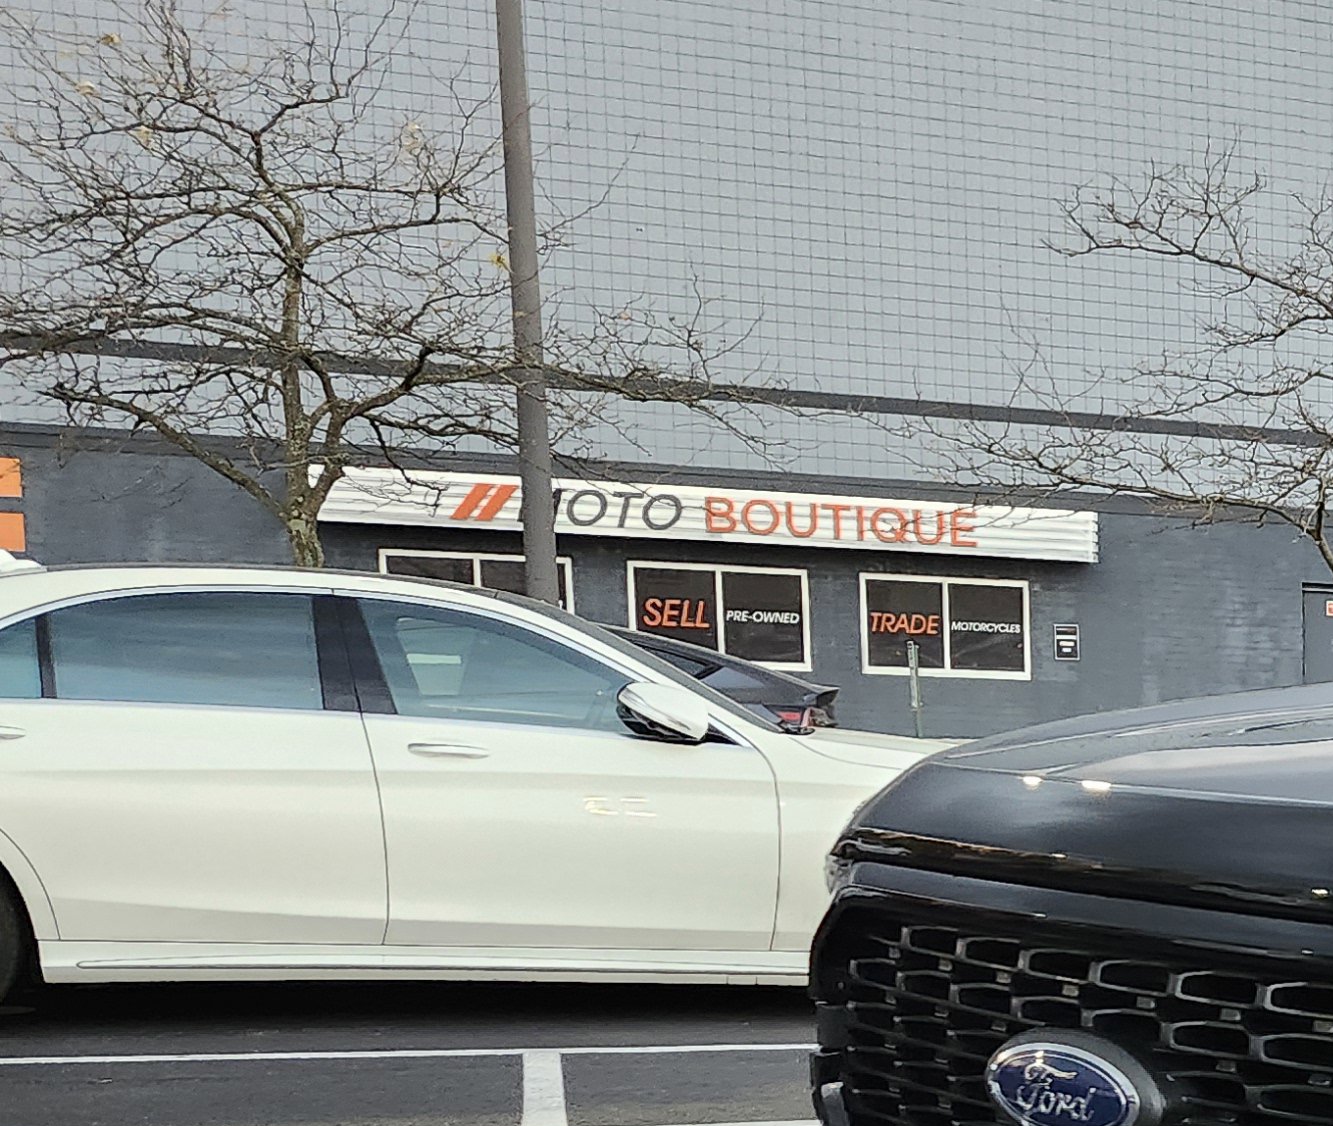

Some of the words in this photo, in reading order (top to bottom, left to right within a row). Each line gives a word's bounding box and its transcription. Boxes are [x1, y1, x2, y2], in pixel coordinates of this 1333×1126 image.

[705, 497, 977, 547] BOUTIQUE
[643, 598, 710, 629] SELL
[726, 610, 799, 625] PRE-OWNED
[870, 612, 940, 635] TRADE
[951, 621, 1021, 634] MOTORCYCLES
[1016, 1051, 1095, 1121] Ford
